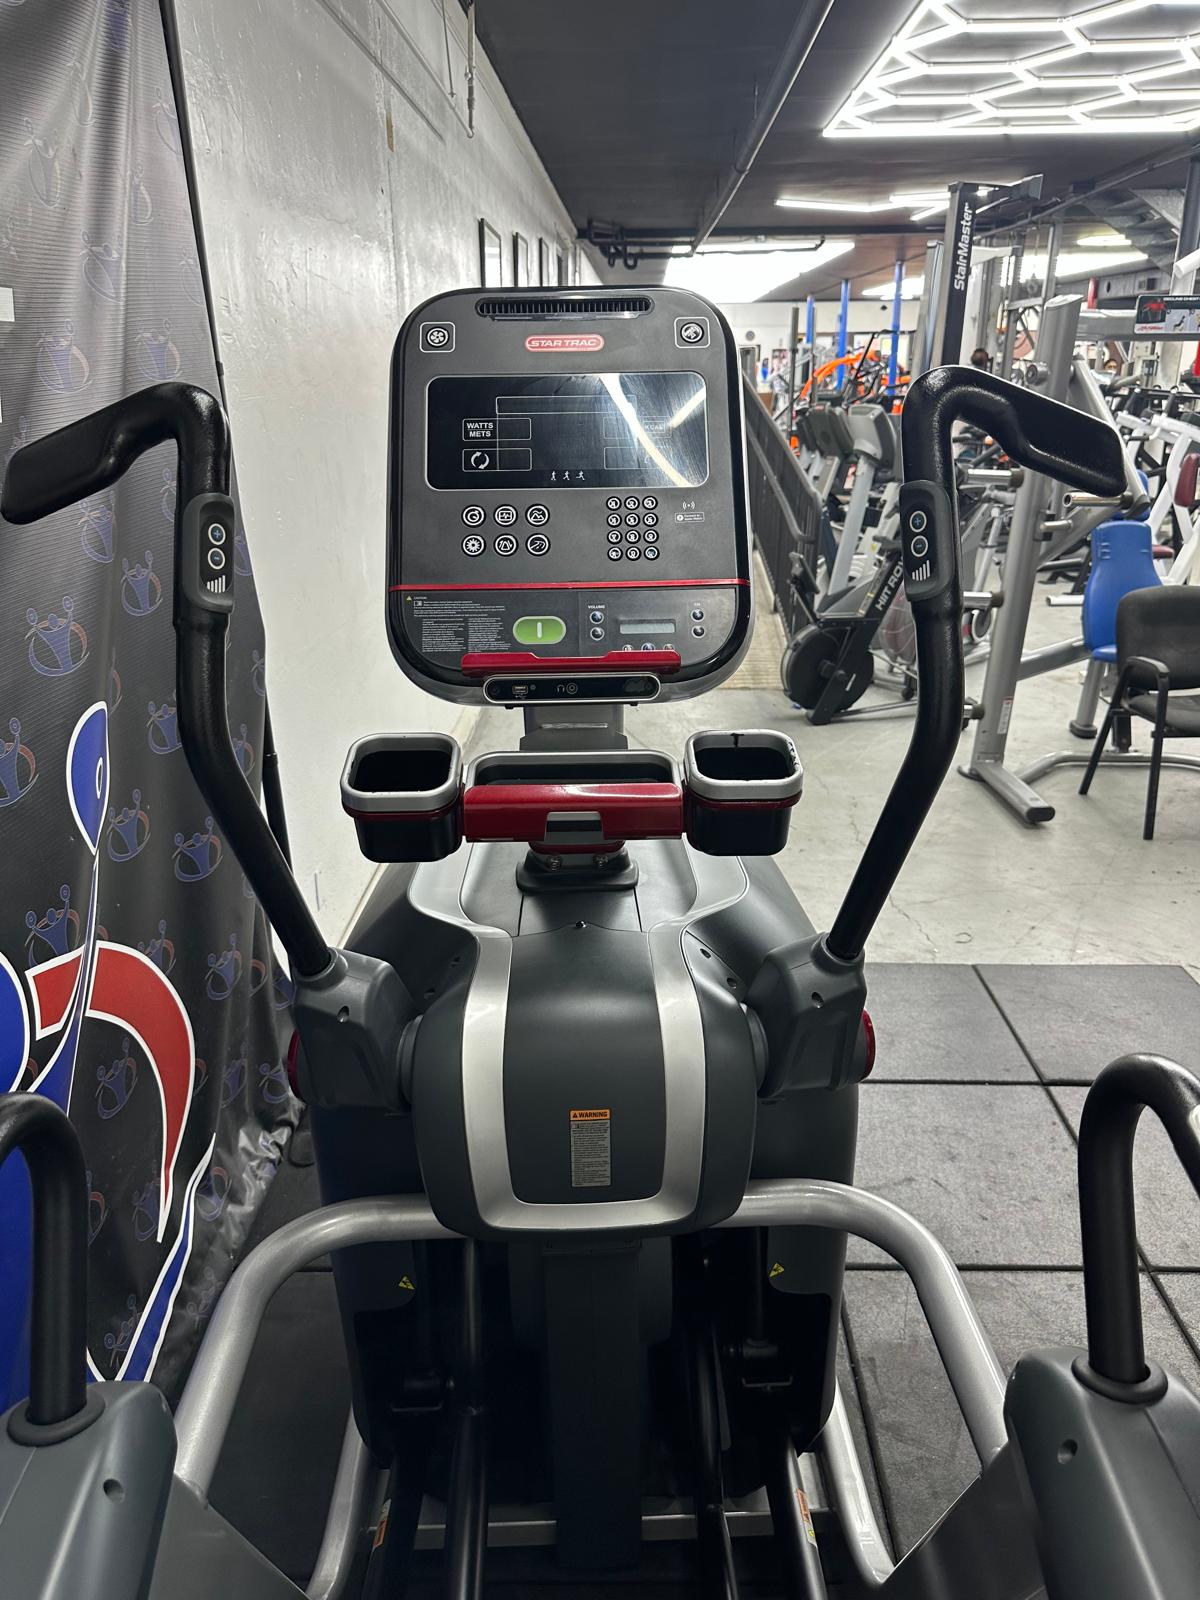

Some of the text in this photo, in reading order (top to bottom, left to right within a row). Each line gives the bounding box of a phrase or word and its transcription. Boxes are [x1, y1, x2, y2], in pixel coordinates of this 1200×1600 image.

[953, 202, 974, 291] StairMaster
[528, 338, 598, 348] STAR TRAC
[466, 422, 494, 430] WATTS
[469, 430, 492, 438] METS
[875, 586, 891, 610] HIT
